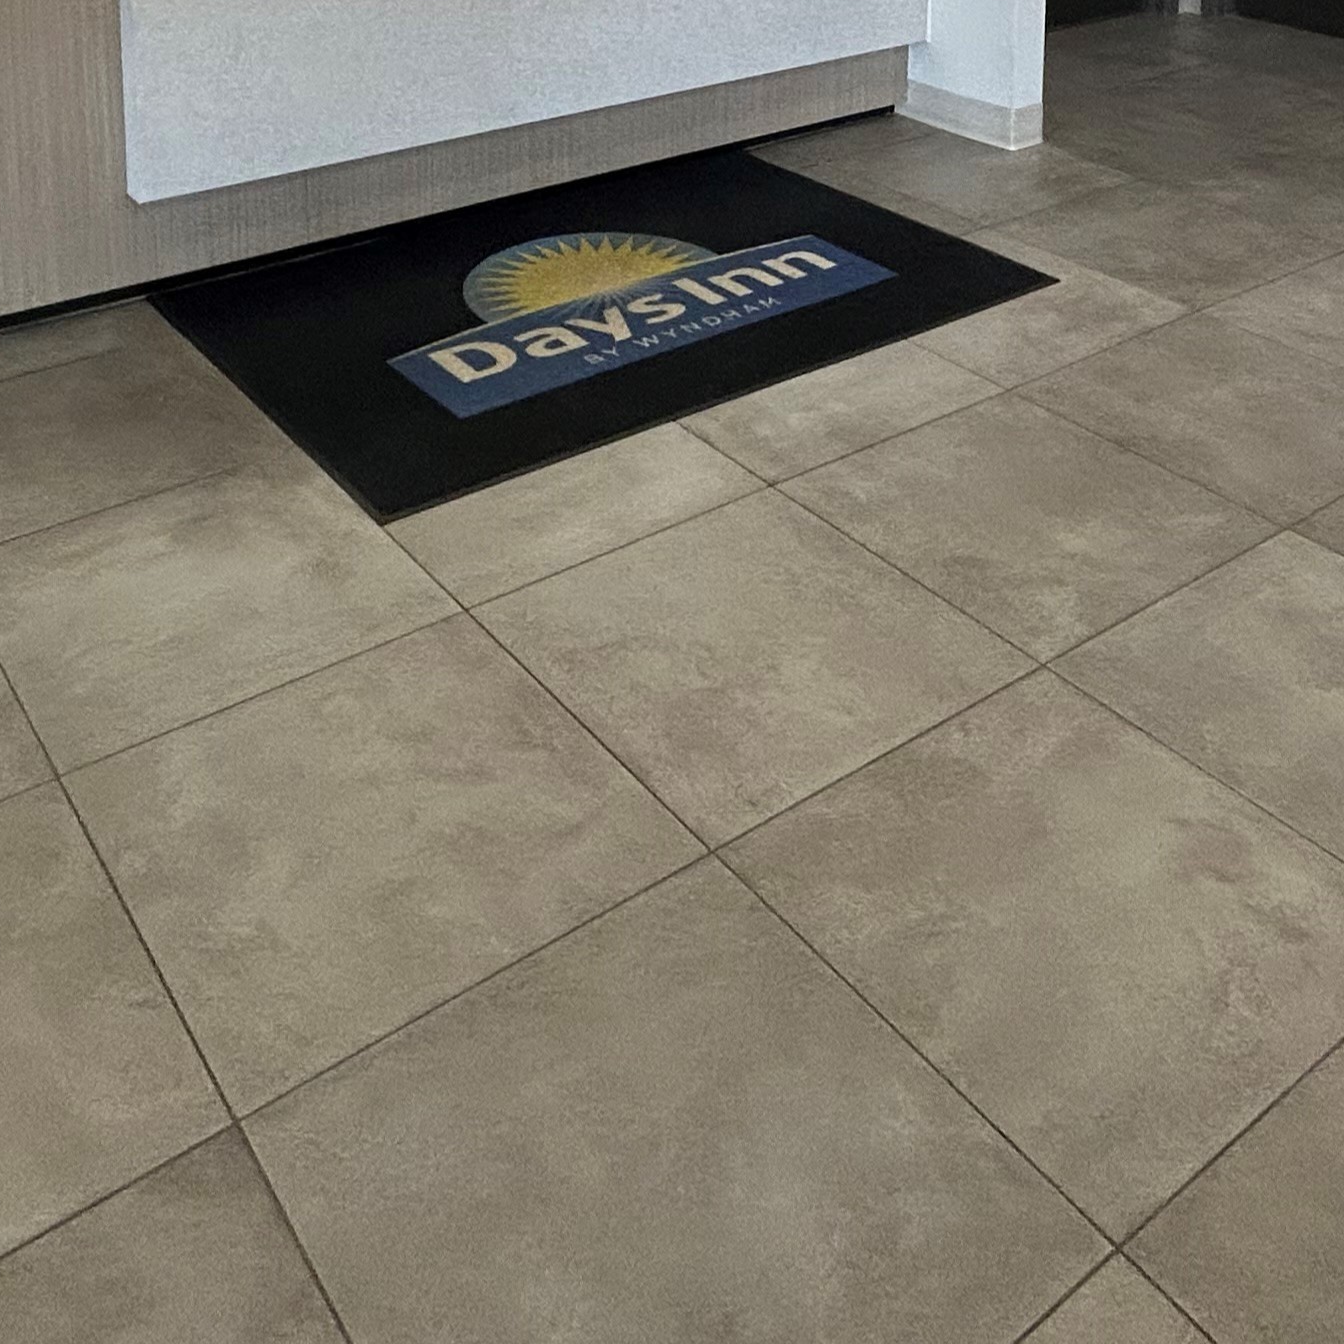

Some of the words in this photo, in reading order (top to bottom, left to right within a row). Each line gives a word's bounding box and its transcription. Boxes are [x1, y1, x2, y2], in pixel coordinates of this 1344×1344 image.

[427, 293, 686, 384] Days
[672, 249, 838, 304] Inn
[583, 346, 622, 366] BY
[632, 296, 783, 350] WYNDHAM
